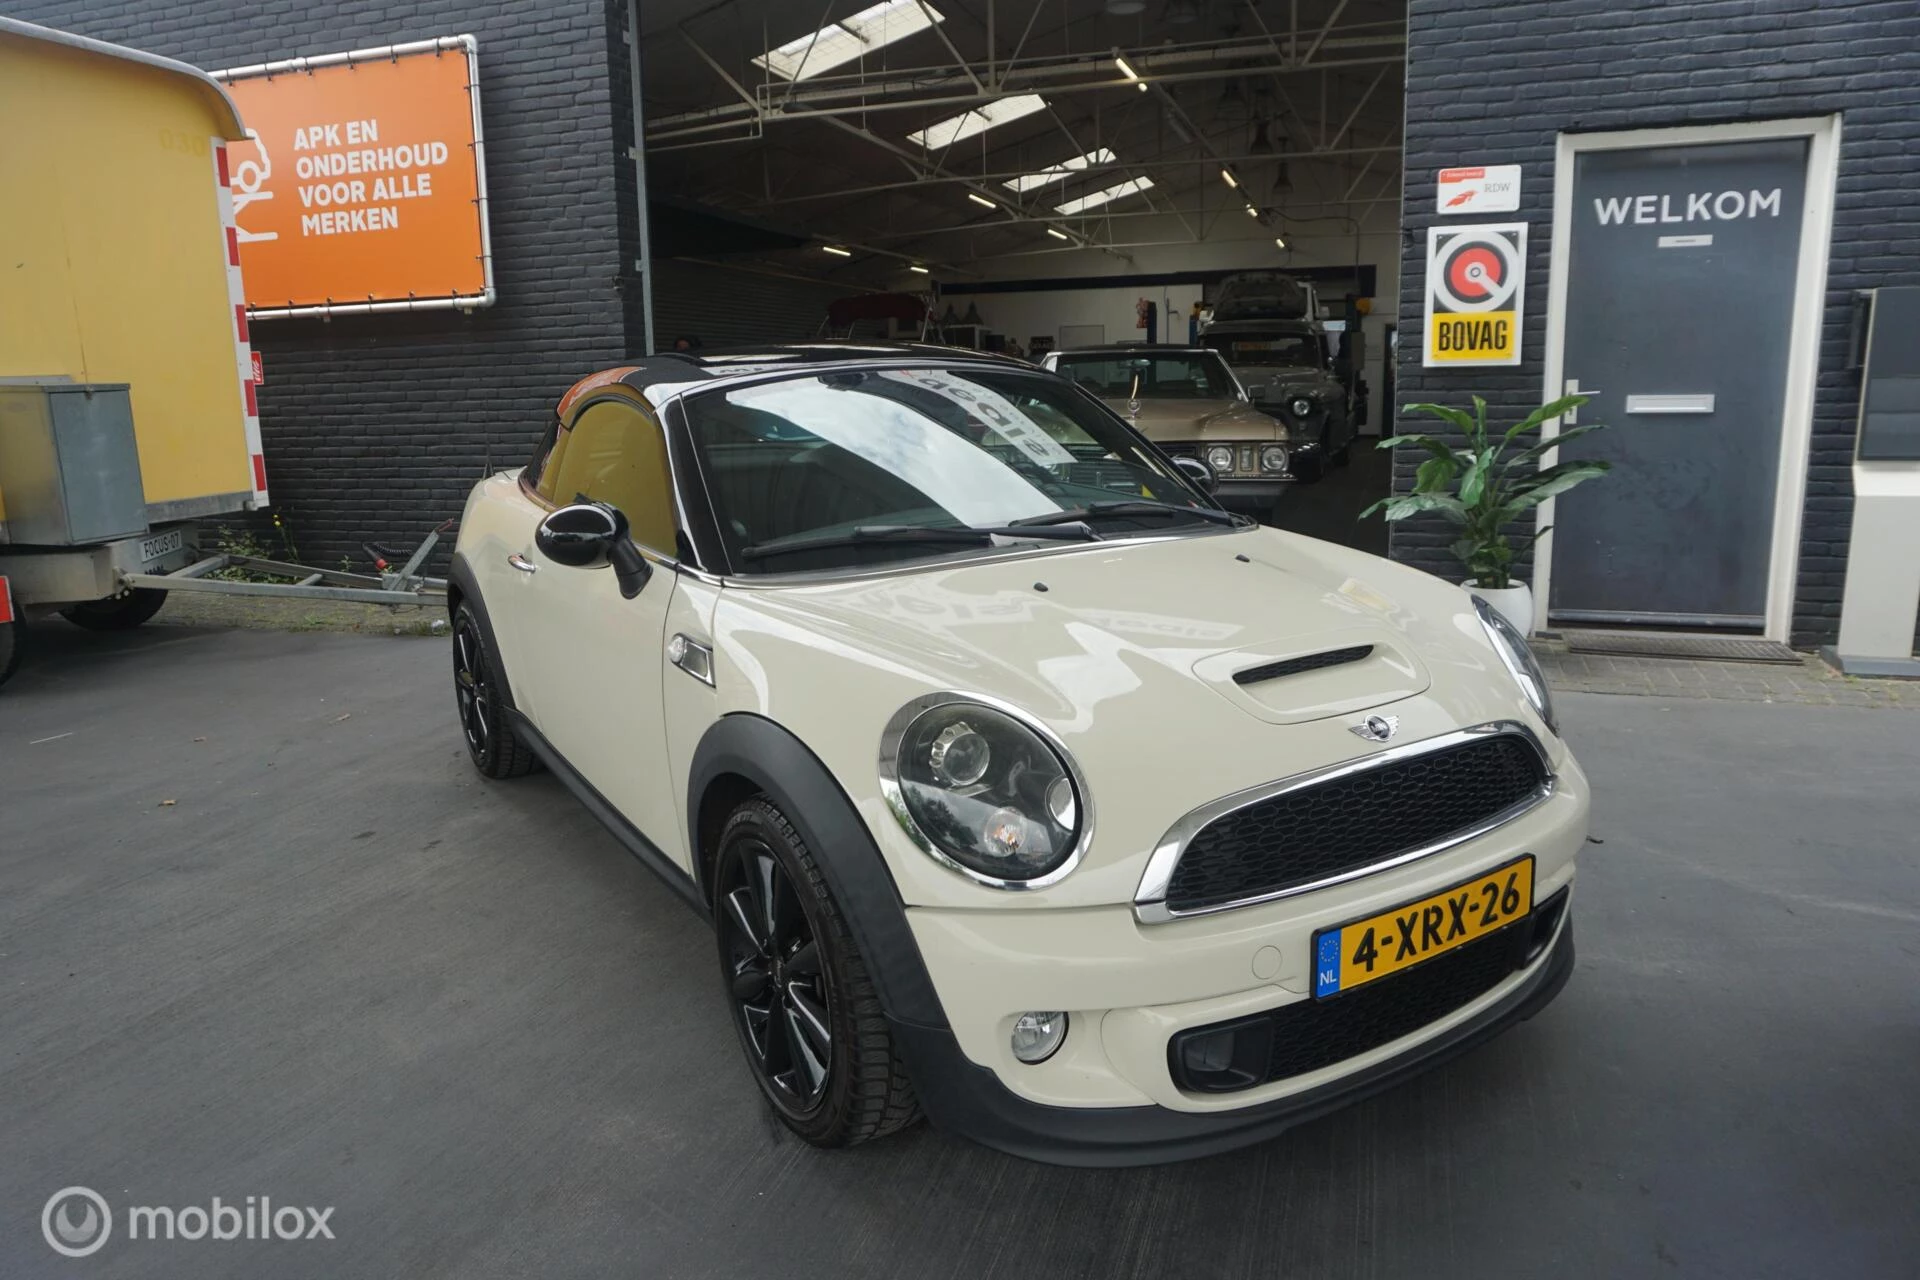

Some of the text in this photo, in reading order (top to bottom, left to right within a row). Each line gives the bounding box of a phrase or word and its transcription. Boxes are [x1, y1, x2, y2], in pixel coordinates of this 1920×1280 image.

[294, 119, 378, 150] APK EN
[296, 141, 448, 179] ONDERHOUD
[298, 173, 432, 208] VOOR ALLE
[1484, 182, 1511, 193] RDW
[302, 206, 399, 236] MERKEN
[1593, 188, 1782, 225] WELKOM
[1438, 320, 1508, 351] BOVAG
[1352, 872, 1520, 972] 4-XRX-26
[1320, 969, 1337, 986] NL
